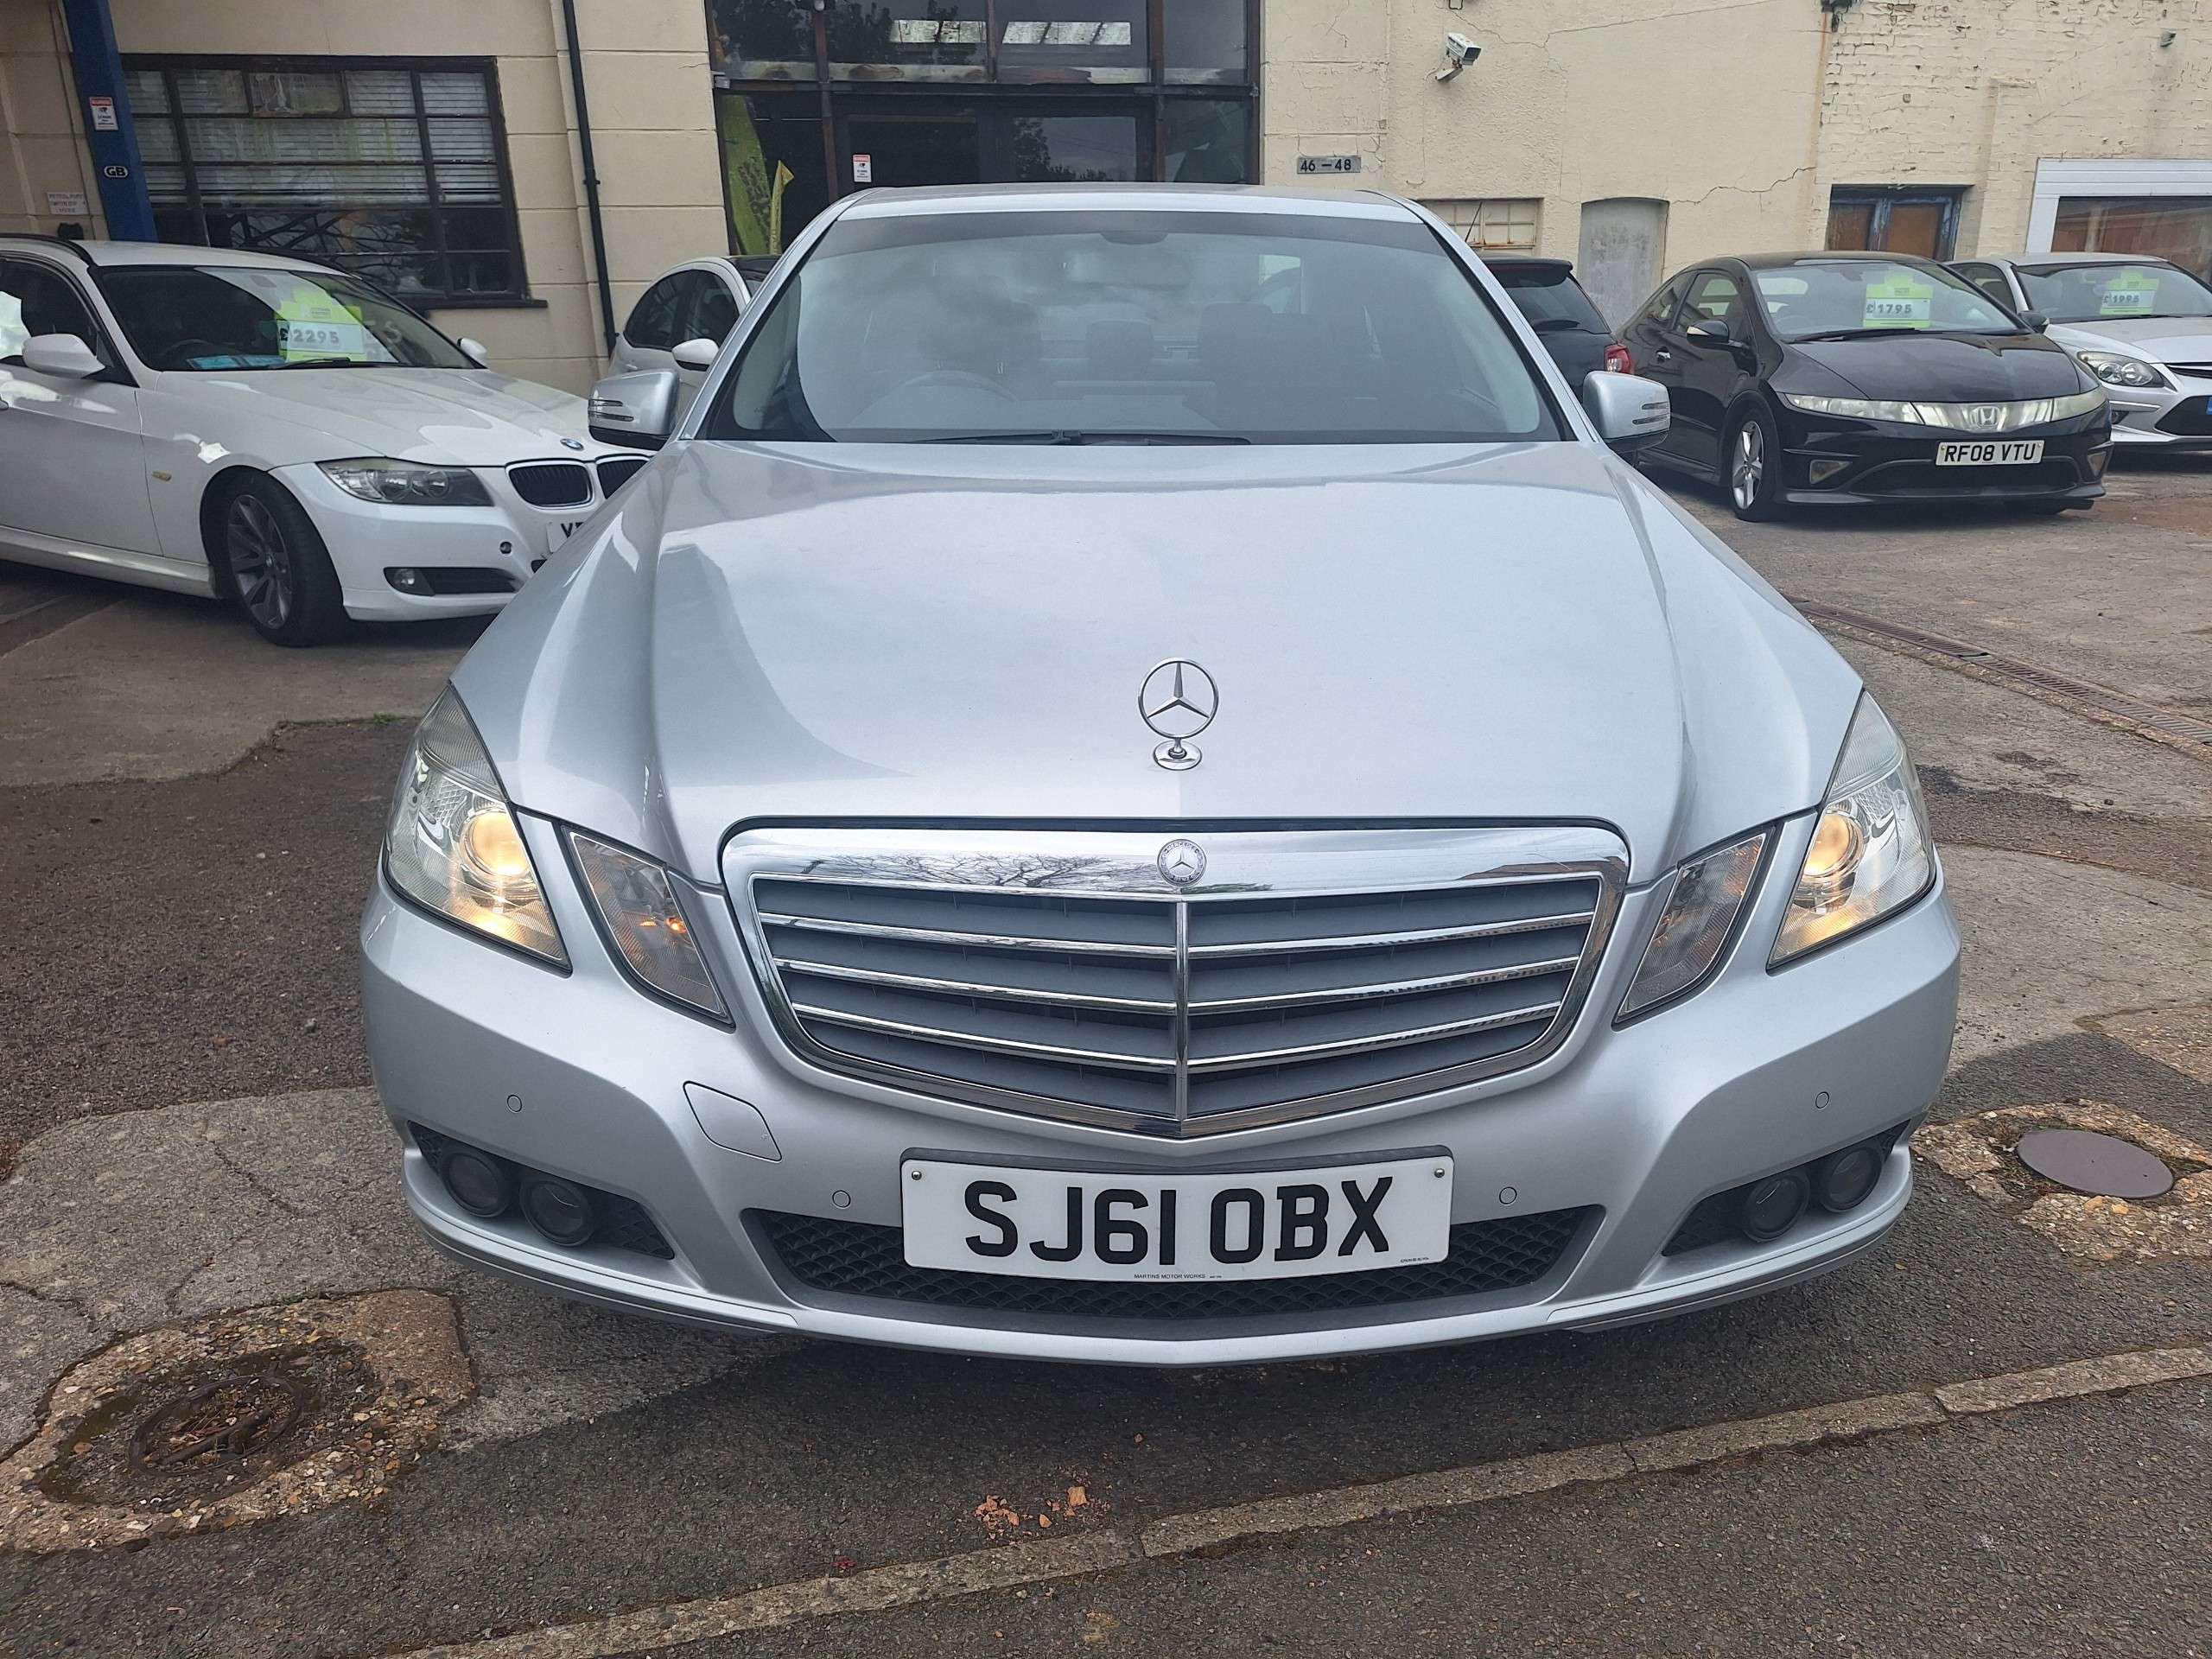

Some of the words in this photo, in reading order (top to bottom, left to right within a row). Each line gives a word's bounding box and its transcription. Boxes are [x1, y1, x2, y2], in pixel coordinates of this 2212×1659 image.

[105, 166, 126, 176] GB
[1300, 160, 1316, 171] 46
[1335, 159, 1351, 171] 48
[279, 327, 340, 344] £2295
[1944, 444, 1995, 462] RF08
[2001, 443, 2037, 461] VTU
[964, 1179, 1178, 1266] SJ61
[1210, 1176, 1394, 1264] OBX
